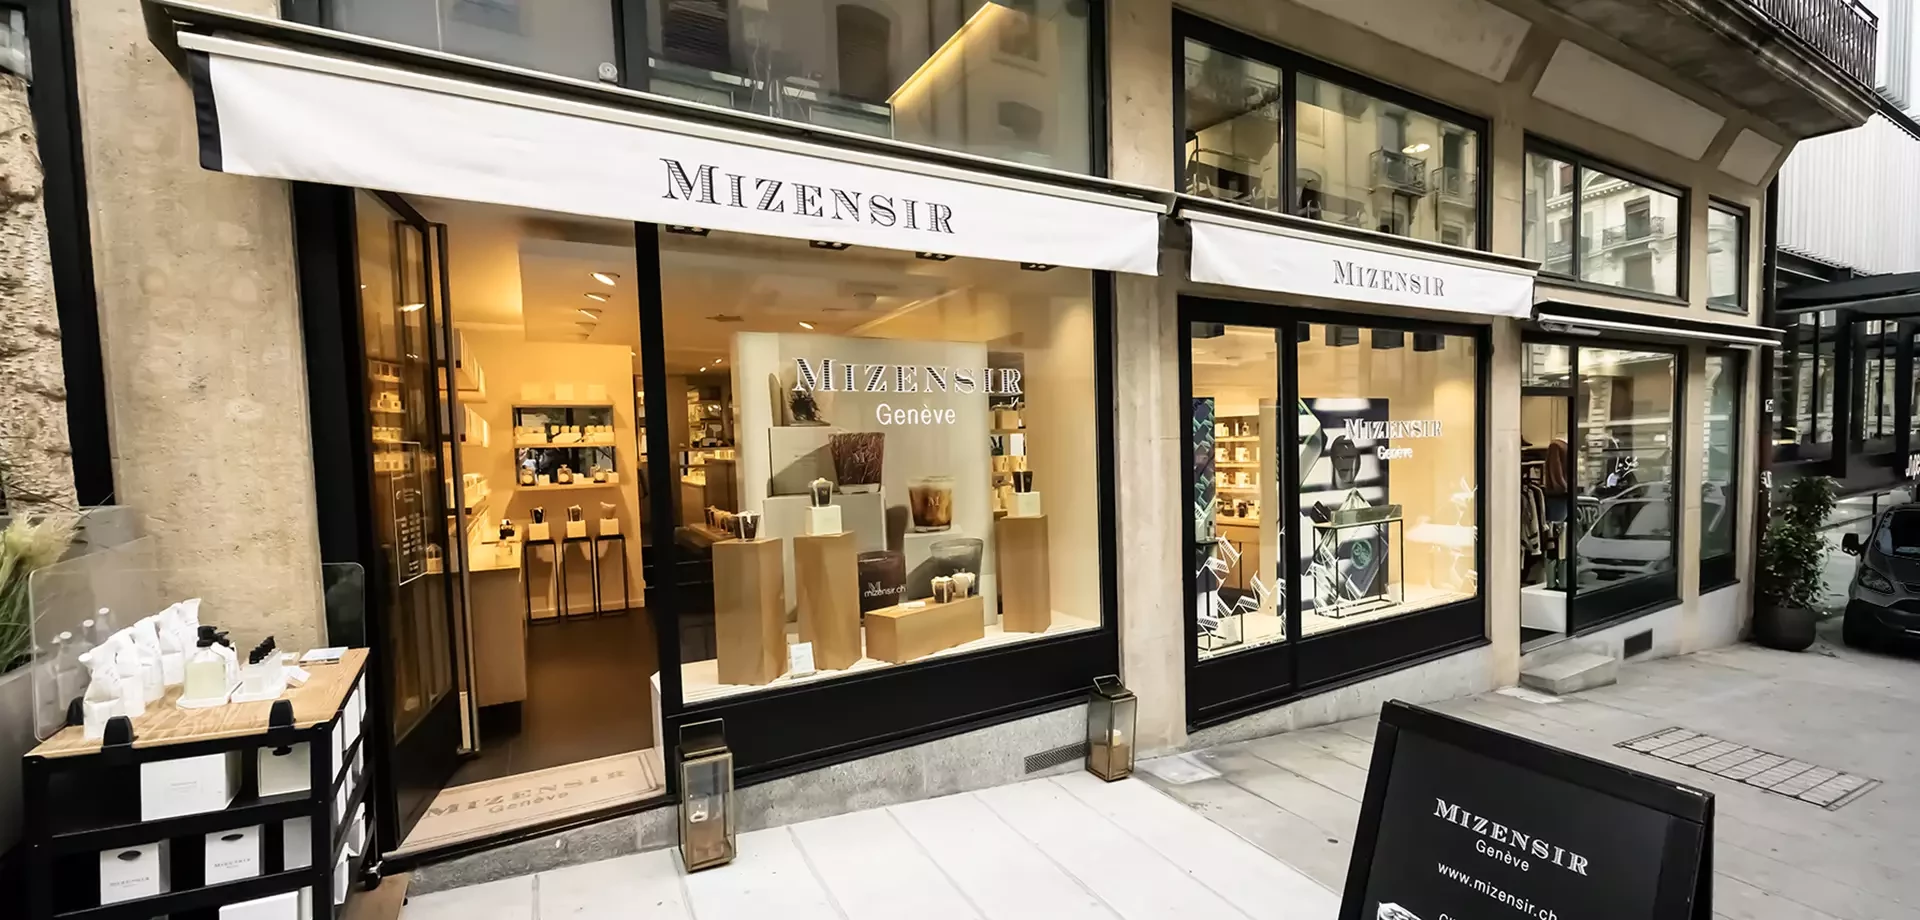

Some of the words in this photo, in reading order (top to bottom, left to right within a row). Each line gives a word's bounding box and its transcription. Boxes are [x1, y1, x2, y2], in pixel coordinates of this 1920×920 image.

[659, 158, 955, 234] MIZENSIR
[1332, 259, 1445, 297] MIZENSIR
[792, 357, 1023, 395] MIZENSIR
[876, 402, 956, 426] Genève
[1343, 418, 1443, 440] MIZENSIR
[1377, 445, 1414, 460] Genève
[423, 769, 626, 819] MIZENSIR
[489, 790, 569, 815] Genève
[1433, 797, 1589, 876] MIZENSIR
[1476, 839, 1530, 872] Genève
[1437, 862, 1559, 920] www.mizensir.ch
